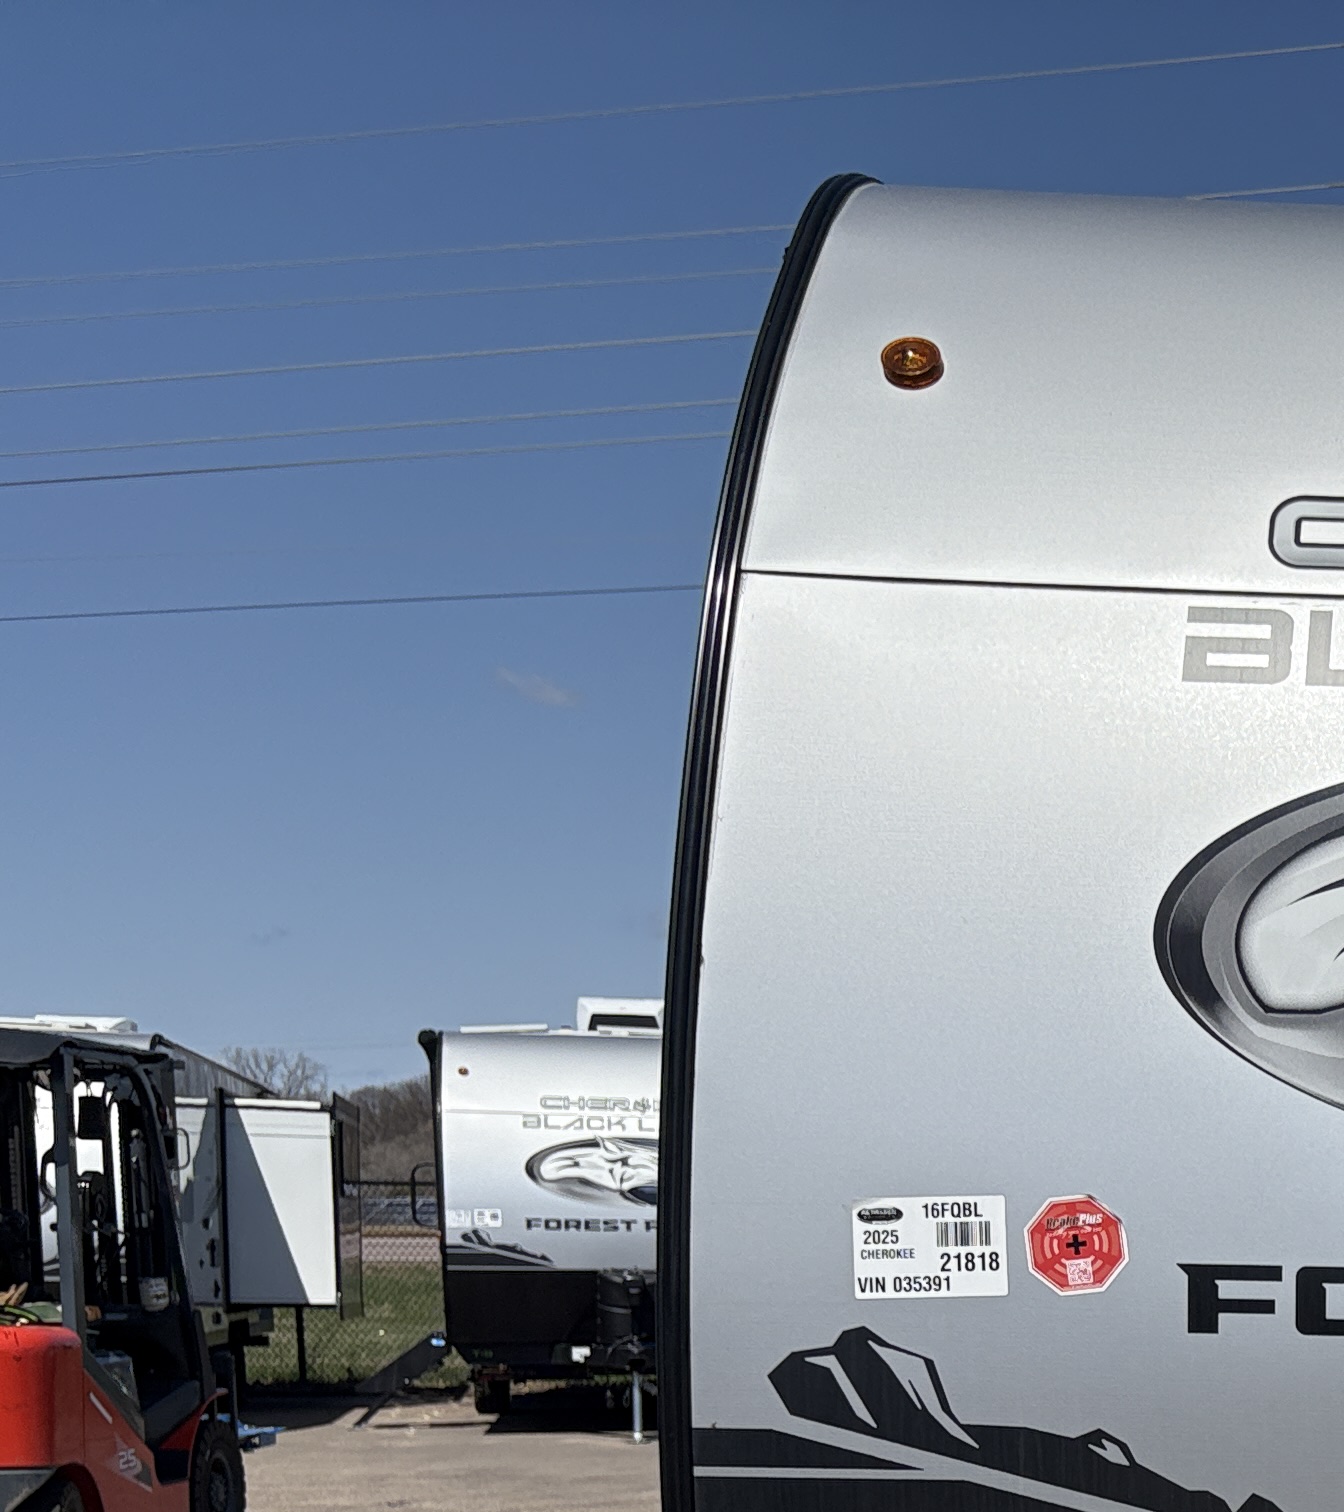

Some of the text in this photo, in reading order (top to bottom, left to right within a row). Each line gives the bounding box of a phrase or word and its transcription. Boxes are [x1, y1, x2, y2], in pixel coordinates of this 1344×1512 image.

[522, 1114, 627, 1131] BLACK
[922, 1202, 983, 1219] 16FQBL
[525, 1217, 637, 1232] FOREST
[862, 1230, 899, 1245] 2025
[860, 1248, 916, 1260] CHEROKEE
[940, 1252, 1000, 1272] 21818
[857, 1275, 951, 1293] VIN 035391
